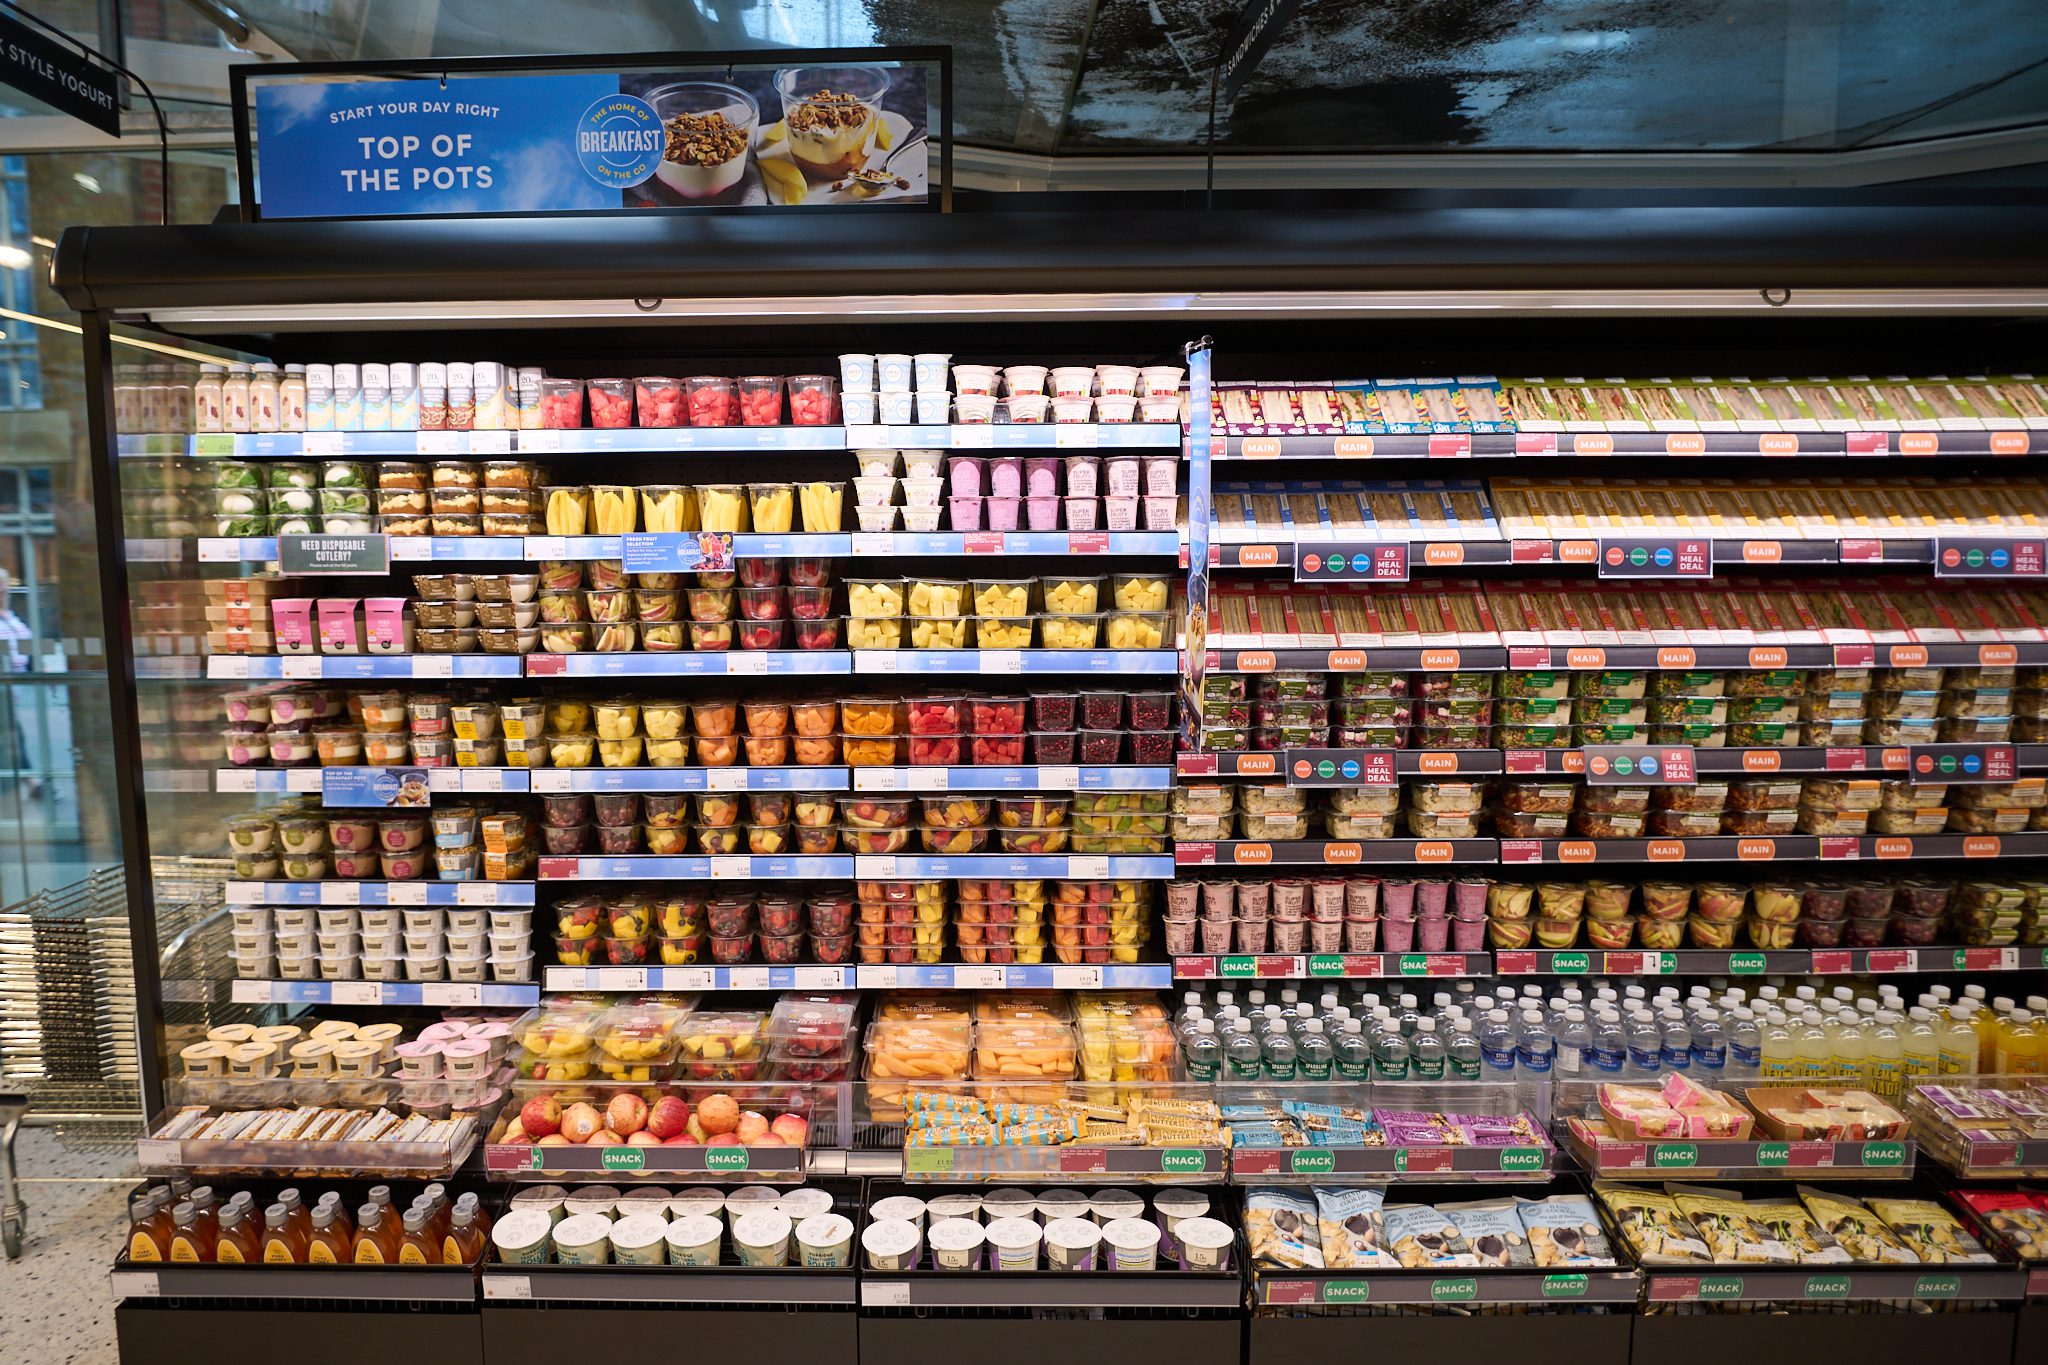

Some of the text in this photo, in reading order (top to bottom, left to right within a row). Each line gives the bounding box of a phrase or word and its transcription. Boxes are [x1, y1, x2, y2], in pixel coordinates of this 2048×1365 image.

[1228, 7, 1268, 76] SANDWICHES
[9, 44, 54, 80] STYLE
[58, 69, 112, 110] YOGURT
[330, 102, 499, 124] START YOUR DAY RIGHT
[590, 103, 650, 124] THE HOME OF
[580, 130, 660, 153] BREAKFAST
[358, 133, 473, 160] TOP OF
[597, 163, 647, 179] ON THE GO
[341, 165, 493, 192] THE POTS
[1340, 443, 1367, 451] MAIN
[1580, 441, 1607, 449] MAIN
[1672, 441, 1699, 449] MAIN
[1765, 440, 1792, 449] MAIN
[1904, 439, 1932, 448] MAIN
[1996, 439, 2023, 447] MAIN
[1247, 444, 1275, 452] MAIN
[301, 540, 366, 550] NEED DISPOSABLE
[1687, 544, 1698, 553] £6
[1384, 550, 1395, 558] £6
[1431, 550, 1457, 558] MAIN
[1565, 547, 1591, 556] MAIN
[1748, 548, 1775, 557] MAIN
[2022, 546, 2033, 554] £6
[316, 551, 352, 562] CUTLERY?
[1245, 552, 1271, 560] MAIN
[1680, 555, 1704, 563] MEAL
[1680, 563, 1704, 571] DEAL
[2015, 564, 2040, 572] DEAL
[1377, 568, 1401, 576] DEAL
[1427, 655, 1454, 664] MAIN
[1573, 654, 1600, 663] MAIN
[1663, 654, 1690, 662] MAIN
[1755, 653, 1781, 662] MAIN
[1895, 652, 1922, 661] MAIN
[1985, 651, 2012, 660] MAIN
[1243, 658, 1270, 666] MAIN
[1334, 656, 1361, 665] MAIN
[1671, 753, 1682, 761] £6
[1888, 756, 1910, 764] MAI
[1994, 752, 2005, 760] £6
[1243, 760, 1269, 769] MAIN
[1373, 757, 1384, 765] £6
[1425, 758, 1452, 768] MAIN
[1568, 758, 1584, 766] MA
[1749, 757, 1775, 766] MAIN
[1665, 763, 1689, 772] MEAL
[1988, 762, 2012, 770] MEAL
[1367, 767, 1390, 775] MEAL
[1666, 771, 1690, 779] DEAL
[1653, 847, 1679, 855] MAIN
[1743, 846, 1769, 854] MAIN
[1881, 844, 1907, 852] MAIN
[1969, 843, 1995, 851] MAIN
[1240, 850, 1266, 858] MAIN
[1330, 849, 1356, 857] MAIN
[1421, 848, 1448, 857] MAIN
[1564, 848, 1590, 856] MAIN
[1223, 962, 1255, 971] SNACK
[1312, 962, 1344, 970] SNACK
[1555, 960, 1586, 968] SNACK
[604, 1154, 642, 1164] SNACK
[708, 1154, 746, 1164] SNACK
[1657, 1151, 1694, 1160] SNACK
[1760, 1151, 1789, 1159] SNAC
[1865, 1150, 1902, 1159] SNACK
[1165, 1156, 1202, 1166] SNACK
[1294, 1157, 1332, 1166] SNACK
[1503, 1155, 1540, 1164] SNACK
[1435, 1285, 1473, 1294] SNACK
[1545, 1281, 1585, 1290] SNACK
[1701, 1284, 1739, 1293] SNACK
[1808, 1283, 1847, 1292] SNACK
[1918, 1283, 1956, 1292] SNACK
[1326, 1287, 1366, 1296] SNACK
